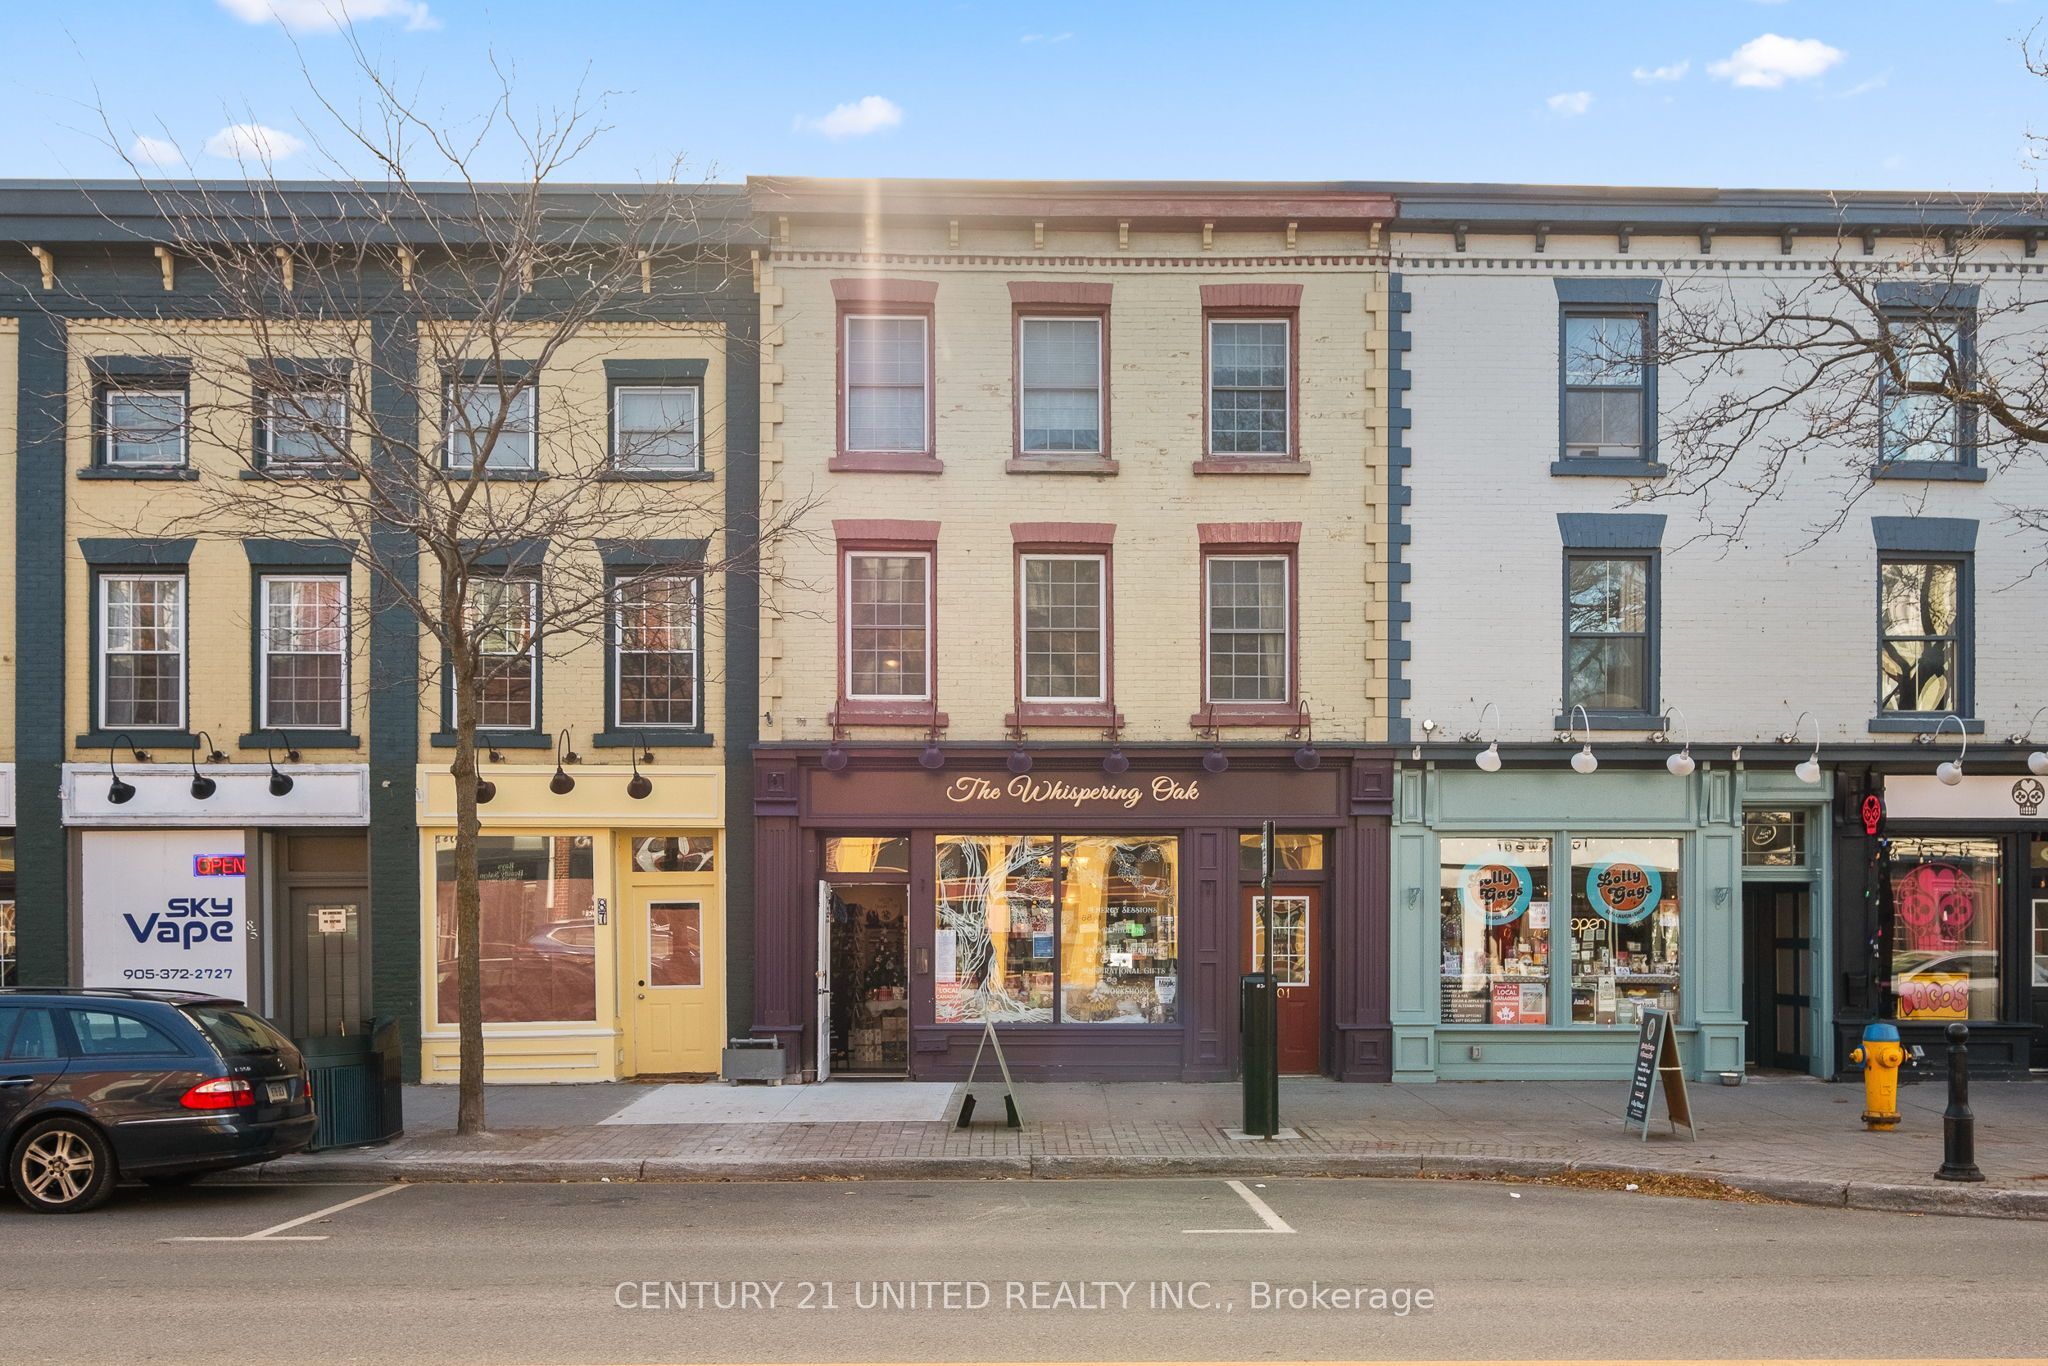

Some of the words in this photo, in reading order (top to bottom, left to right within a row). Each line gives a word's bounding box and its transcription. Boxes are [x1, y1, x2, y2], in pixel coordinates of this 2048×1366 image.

[947, 776, 1001, 803] The
[1007, 774, 1143, 809] Whispering
[1151, 775, 1200, 802] Oak
[197, 857, 245, 875] OPEN
[1596, 868, 1641, 888] Lolly
[1607, 884, 1653, 905] Gags
[165, 898, 233, 918] SKY
[1121, 906, 1158, 914] SESSIONS
[123, 912, 234, 950] Vape
[1570, 918, 1607, 939] open
[123, 968, 233, 980] 905-372-2727
[1143, 967, 1167, 975] GIFTS
[1899, 981, 1968, 1016] TACOS
